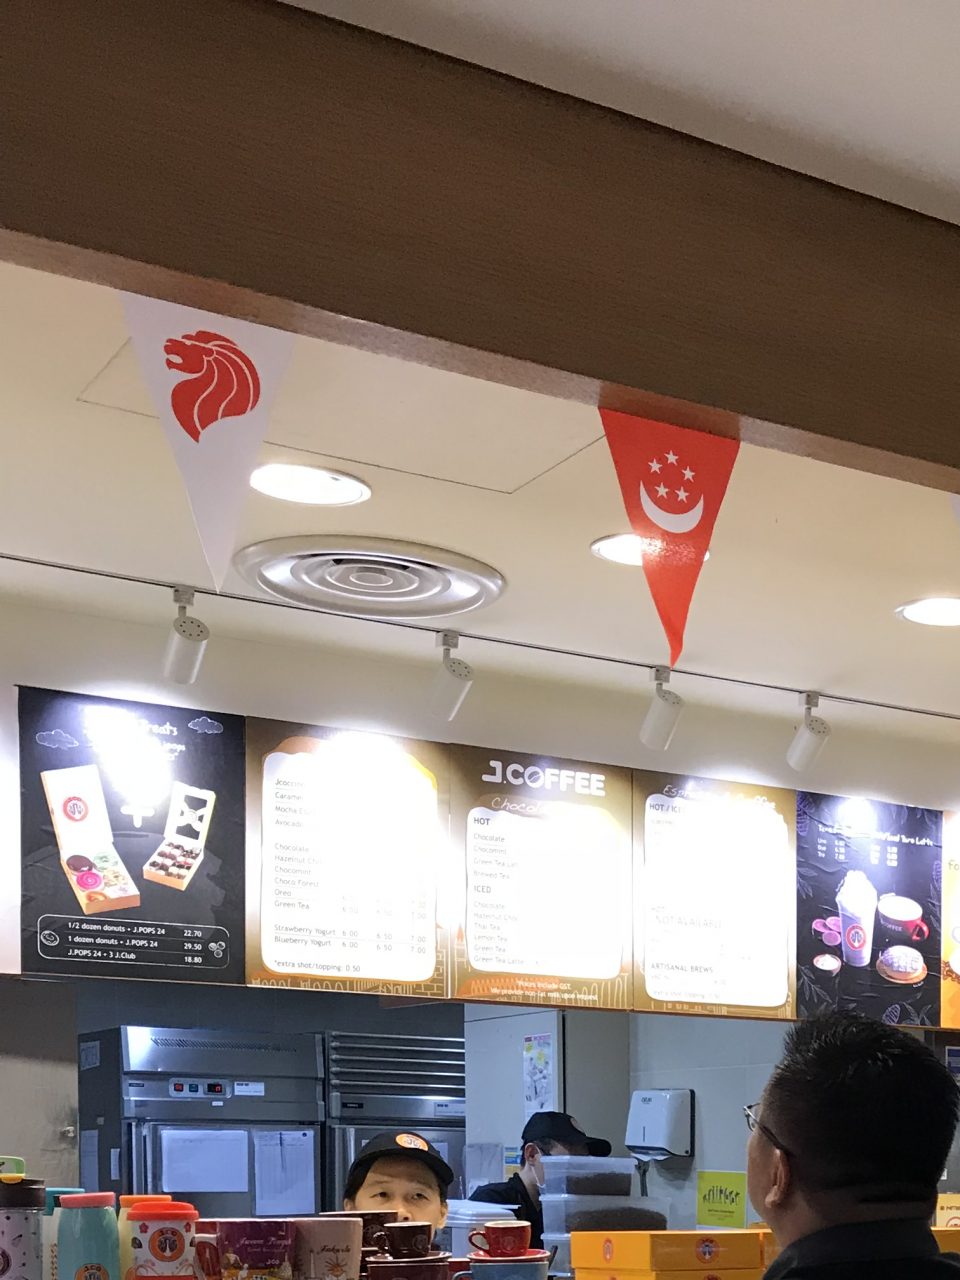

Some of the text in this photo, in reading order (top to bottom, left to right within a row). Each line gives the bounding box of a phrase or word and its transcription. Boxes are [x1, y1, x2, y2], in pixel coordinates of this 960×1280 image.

[649, 803, 664, 811] HOT
[474, 817, 491, 826] HOT
[473, 833, 505, 843] Chocolate
[274, 866, 312, 875] Chocomint
[473, 885, 491, 894] ICED
[274, 901, 296, 909] Green
[298, 902, 310, 910] Tea
[68, 922, 80, 930] 1/2
[103, 924, 125, 932] donuts
[132, 926, 156, 934] J.POPS
[274, 924, 312, 935] Strawberry
[315, 928, 336, 937] Yogurt
[96, 937, 118, 945] donuts
[125, 939, 148, 947] J.POPS
[274, 936, 308, 946] Blueberry
[310, 938, 332, 948] Yogurt
[67, 949, 91, 957] J.POPS
[115, 952, 136, 960] J.Club
[502, 988, 523, 996] provide
